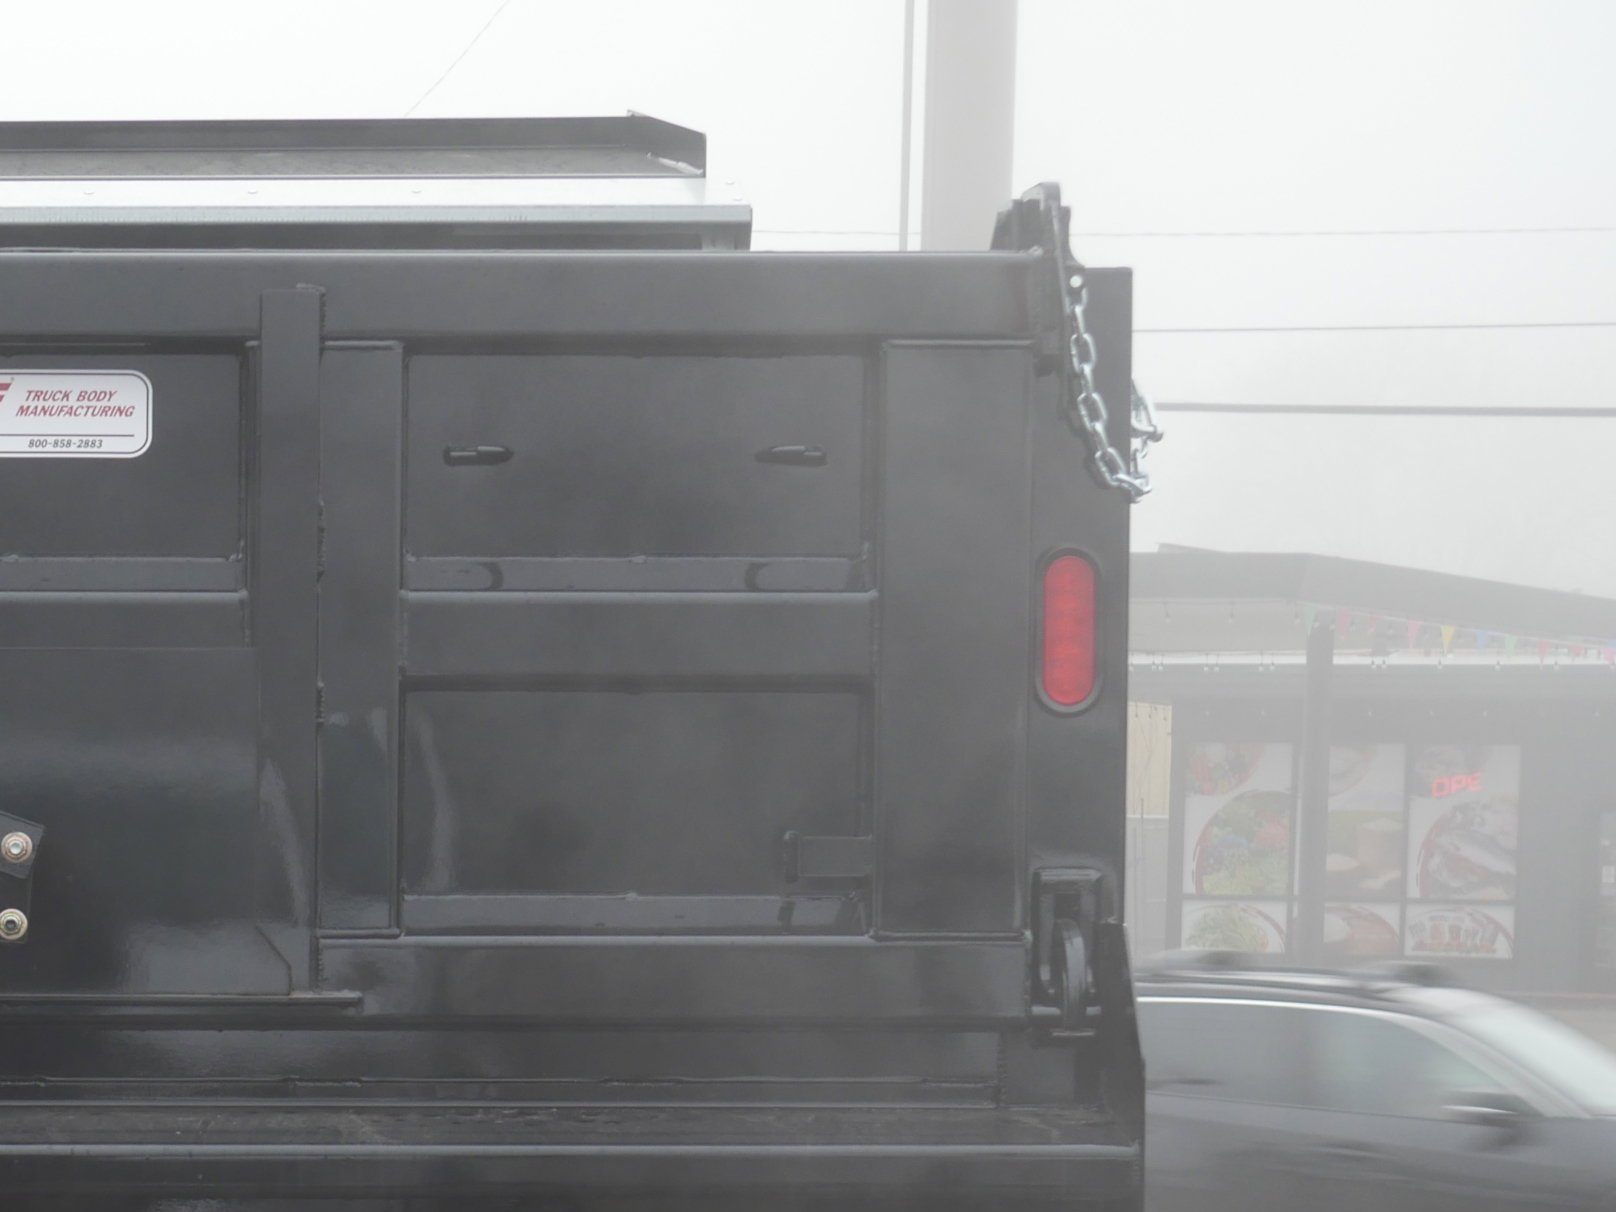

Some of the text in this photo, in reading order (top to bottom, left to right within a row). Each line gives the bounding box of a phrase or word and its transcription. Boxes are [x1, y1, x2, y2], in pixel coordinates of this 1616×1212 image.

[25, 390, 118, 402] TRUCK BODY
[16, 405, 136, 418] MANUFACTURING
[28, 438, 103, 449] 800-858-2883
